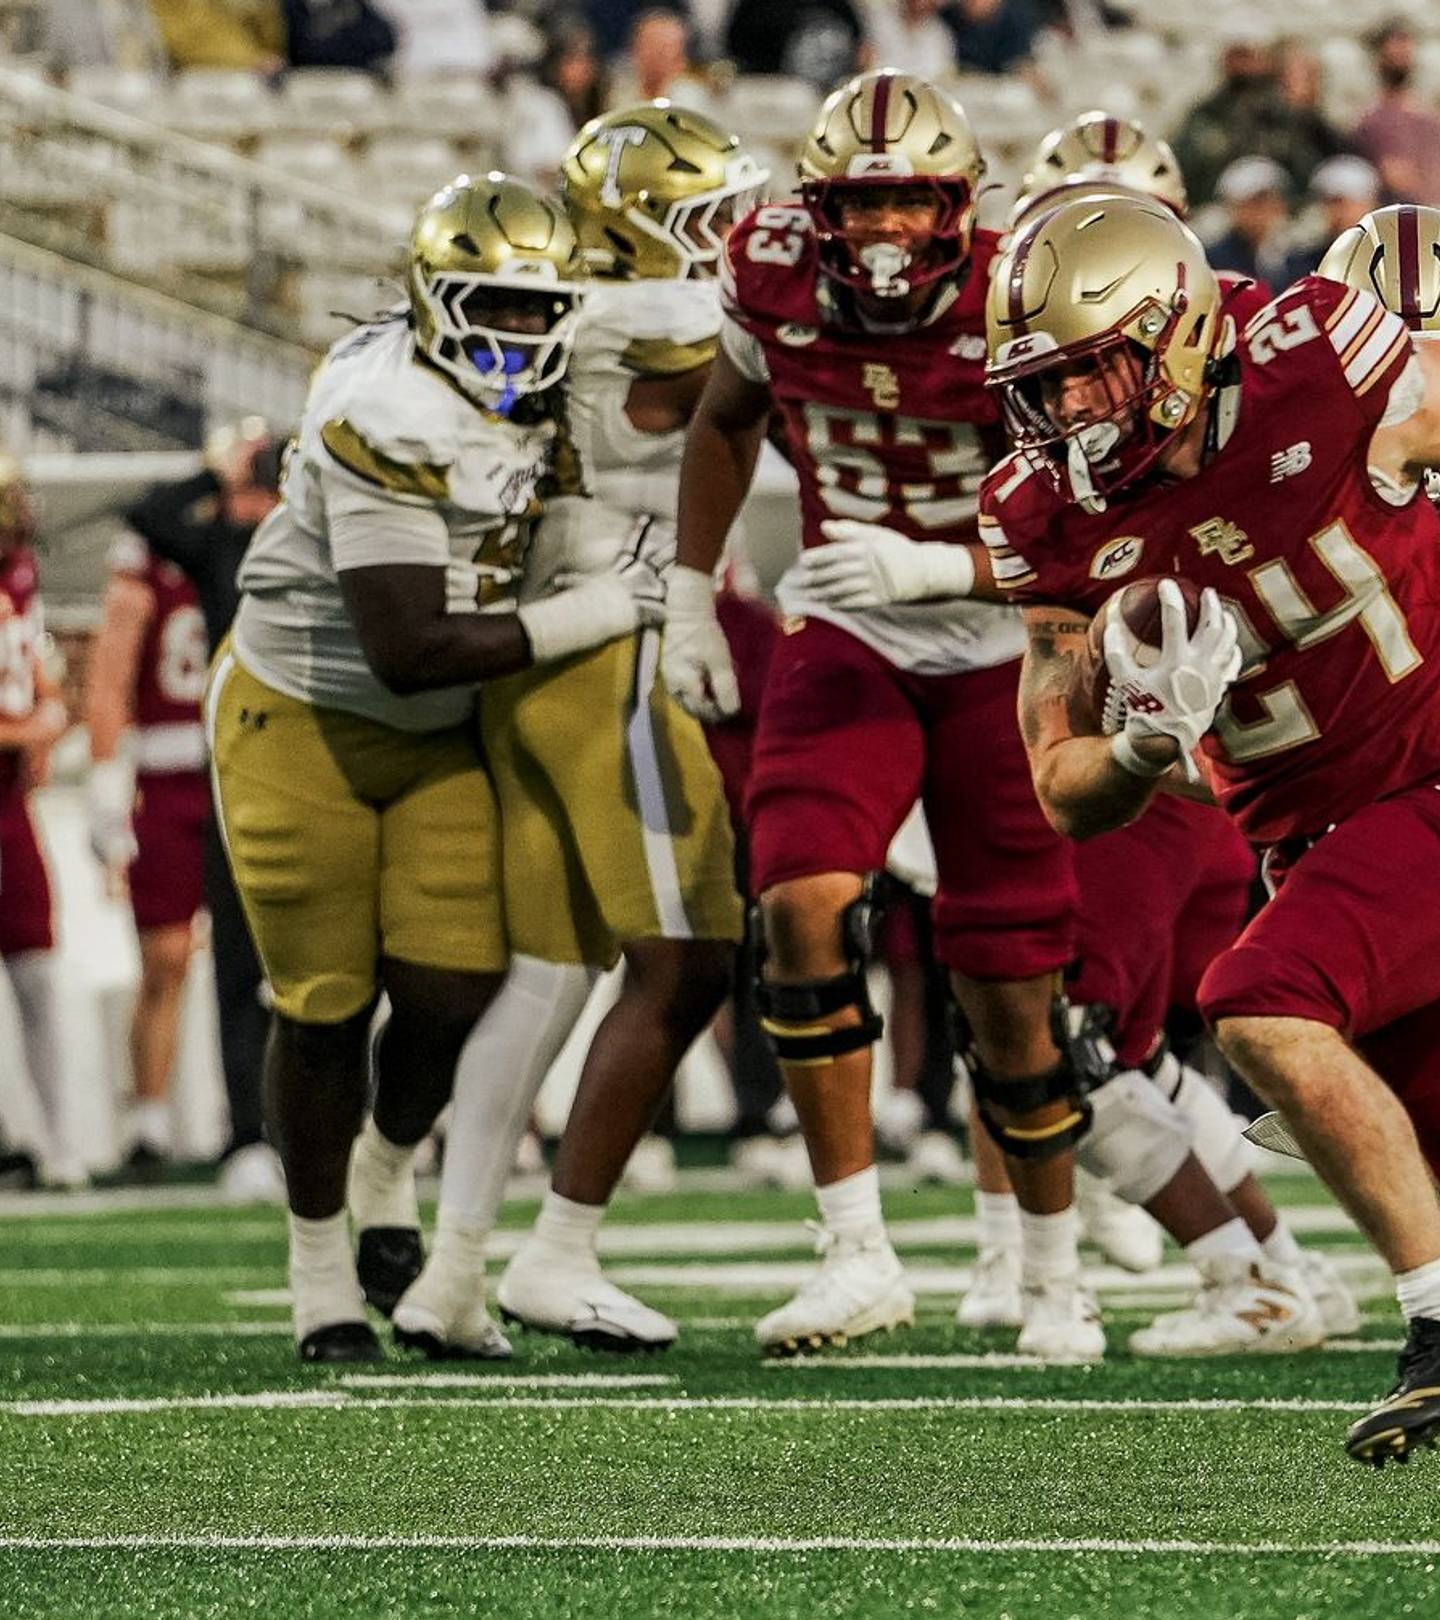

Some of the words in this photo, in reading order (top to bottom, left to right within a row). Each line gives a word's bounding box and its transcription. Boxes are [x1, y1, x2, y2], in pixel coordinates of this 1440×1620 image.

[746, 207, 813, 267] 63
[803, 402, 988, 529] 63
[1100, 540, 1136, 575] ACC
[1215, 517, 1425, 763] 24
